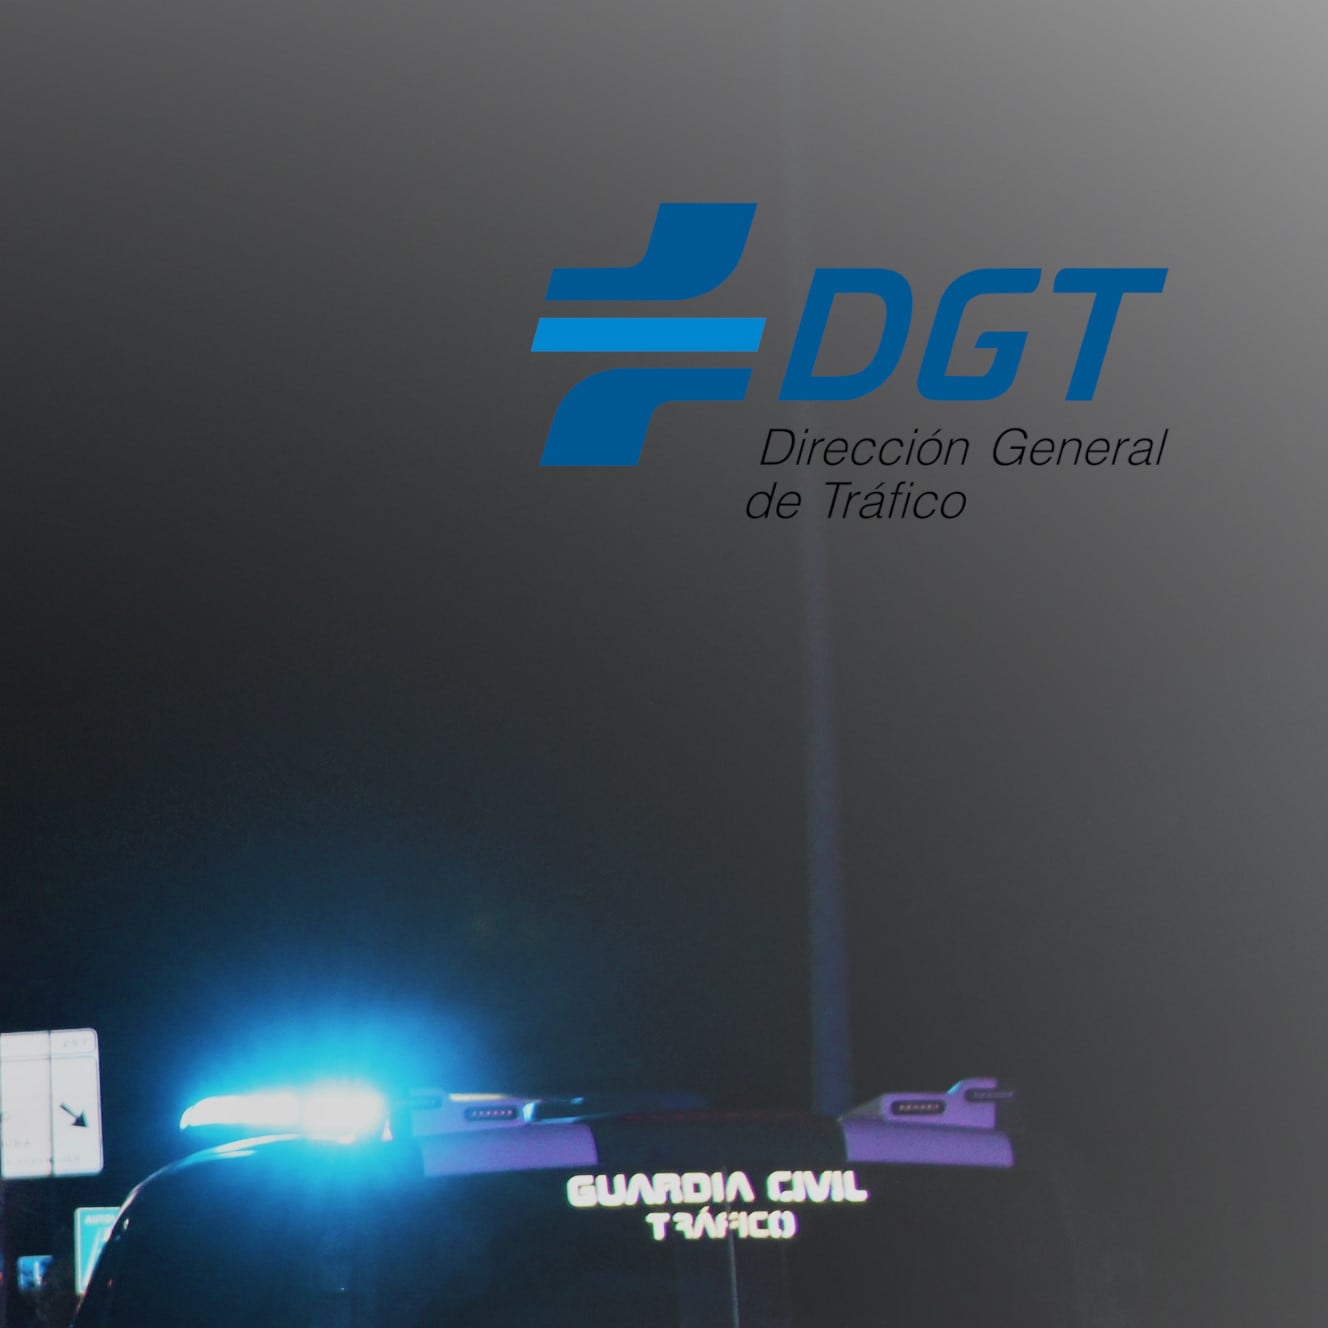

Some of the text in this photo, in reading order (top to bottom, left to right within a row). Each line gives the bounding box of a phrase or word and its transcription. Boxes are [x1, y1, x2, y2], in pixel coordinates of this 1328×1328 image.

[566, 1170, 868, 1207] GUARDIA CIVIL
[646, 1206, 797, 1240] TRÁFICO
